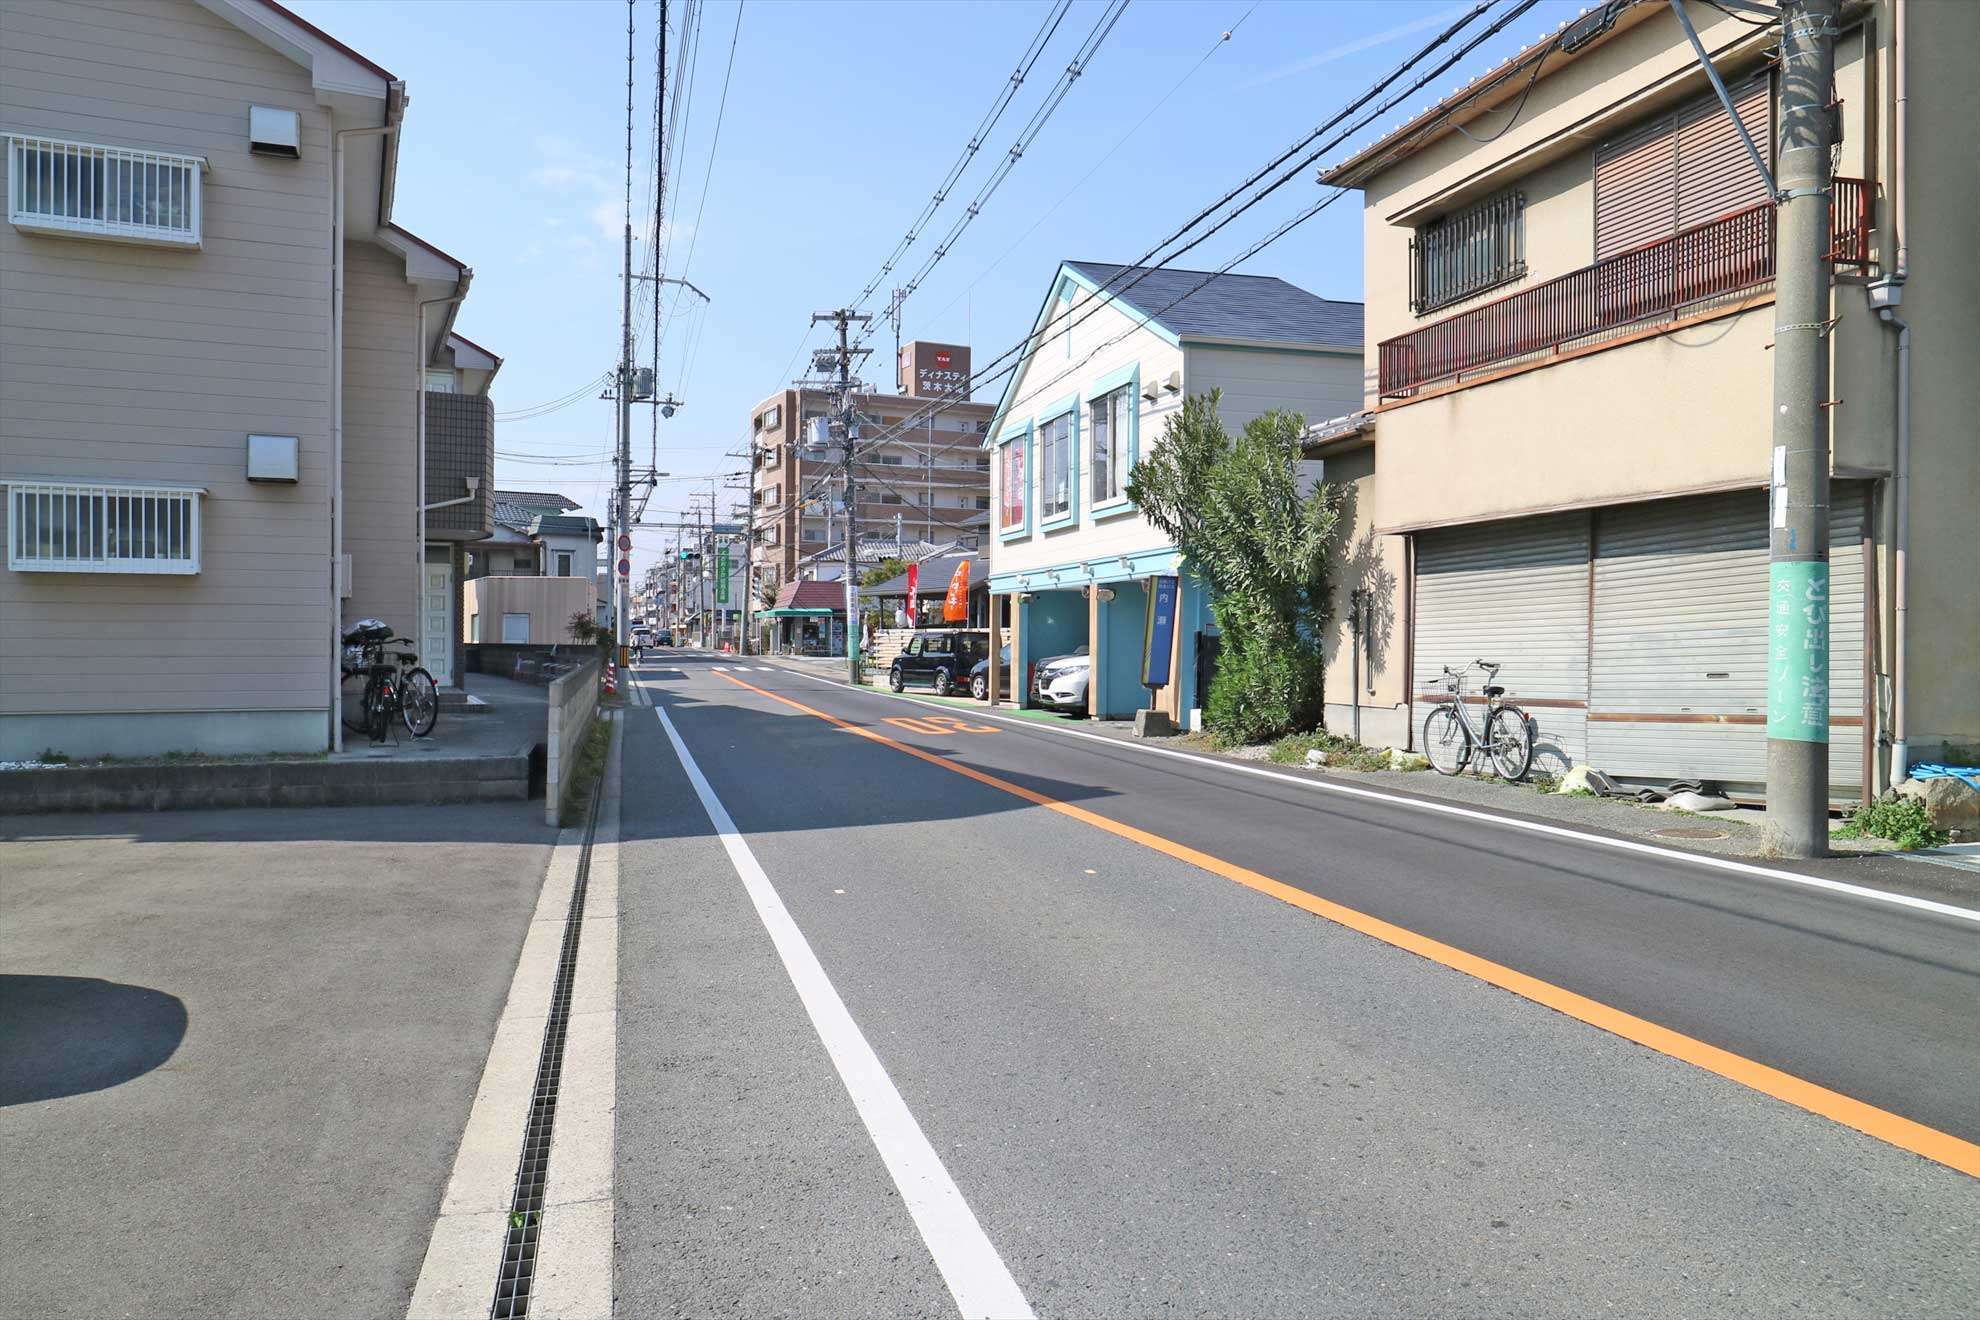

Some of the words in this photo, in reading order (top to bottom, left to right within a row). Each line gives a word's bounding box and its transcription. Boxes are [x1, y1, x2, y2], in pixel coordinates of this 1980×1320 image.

[919, 368, 967, 381] ディナスティ
[1773, 579, 1791, 723] 交通安全ゾーン
[1801, 578, 1826, 726] とび出し注意
